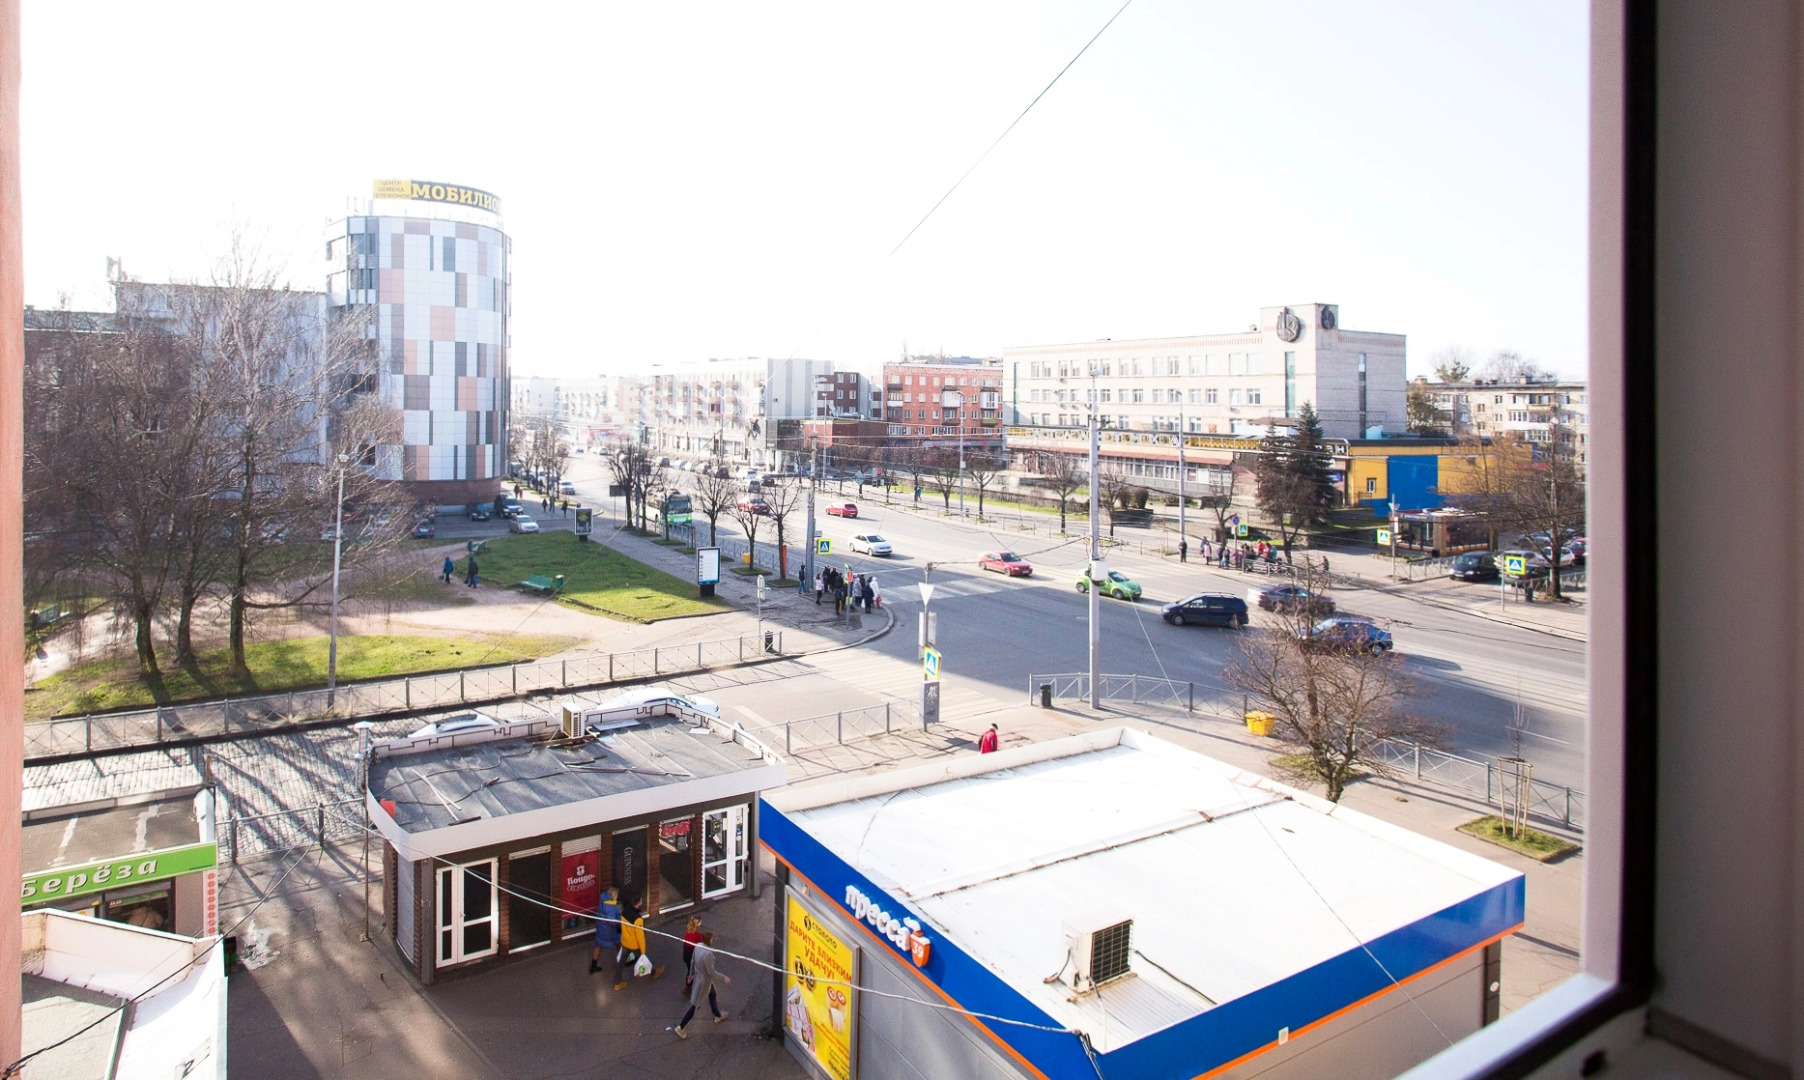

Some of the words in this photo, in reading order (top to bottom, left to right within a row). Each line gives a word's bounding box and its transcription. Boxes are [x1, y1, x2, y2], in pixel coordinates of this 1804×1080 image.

[789, 920, 816, 950] ДАРИТЕ
[817, 946, 852, 984] БЛИЗКИМ
[804, 945, 835, 980] УДАЧУ!
[911, 942, 925, 958] 39
